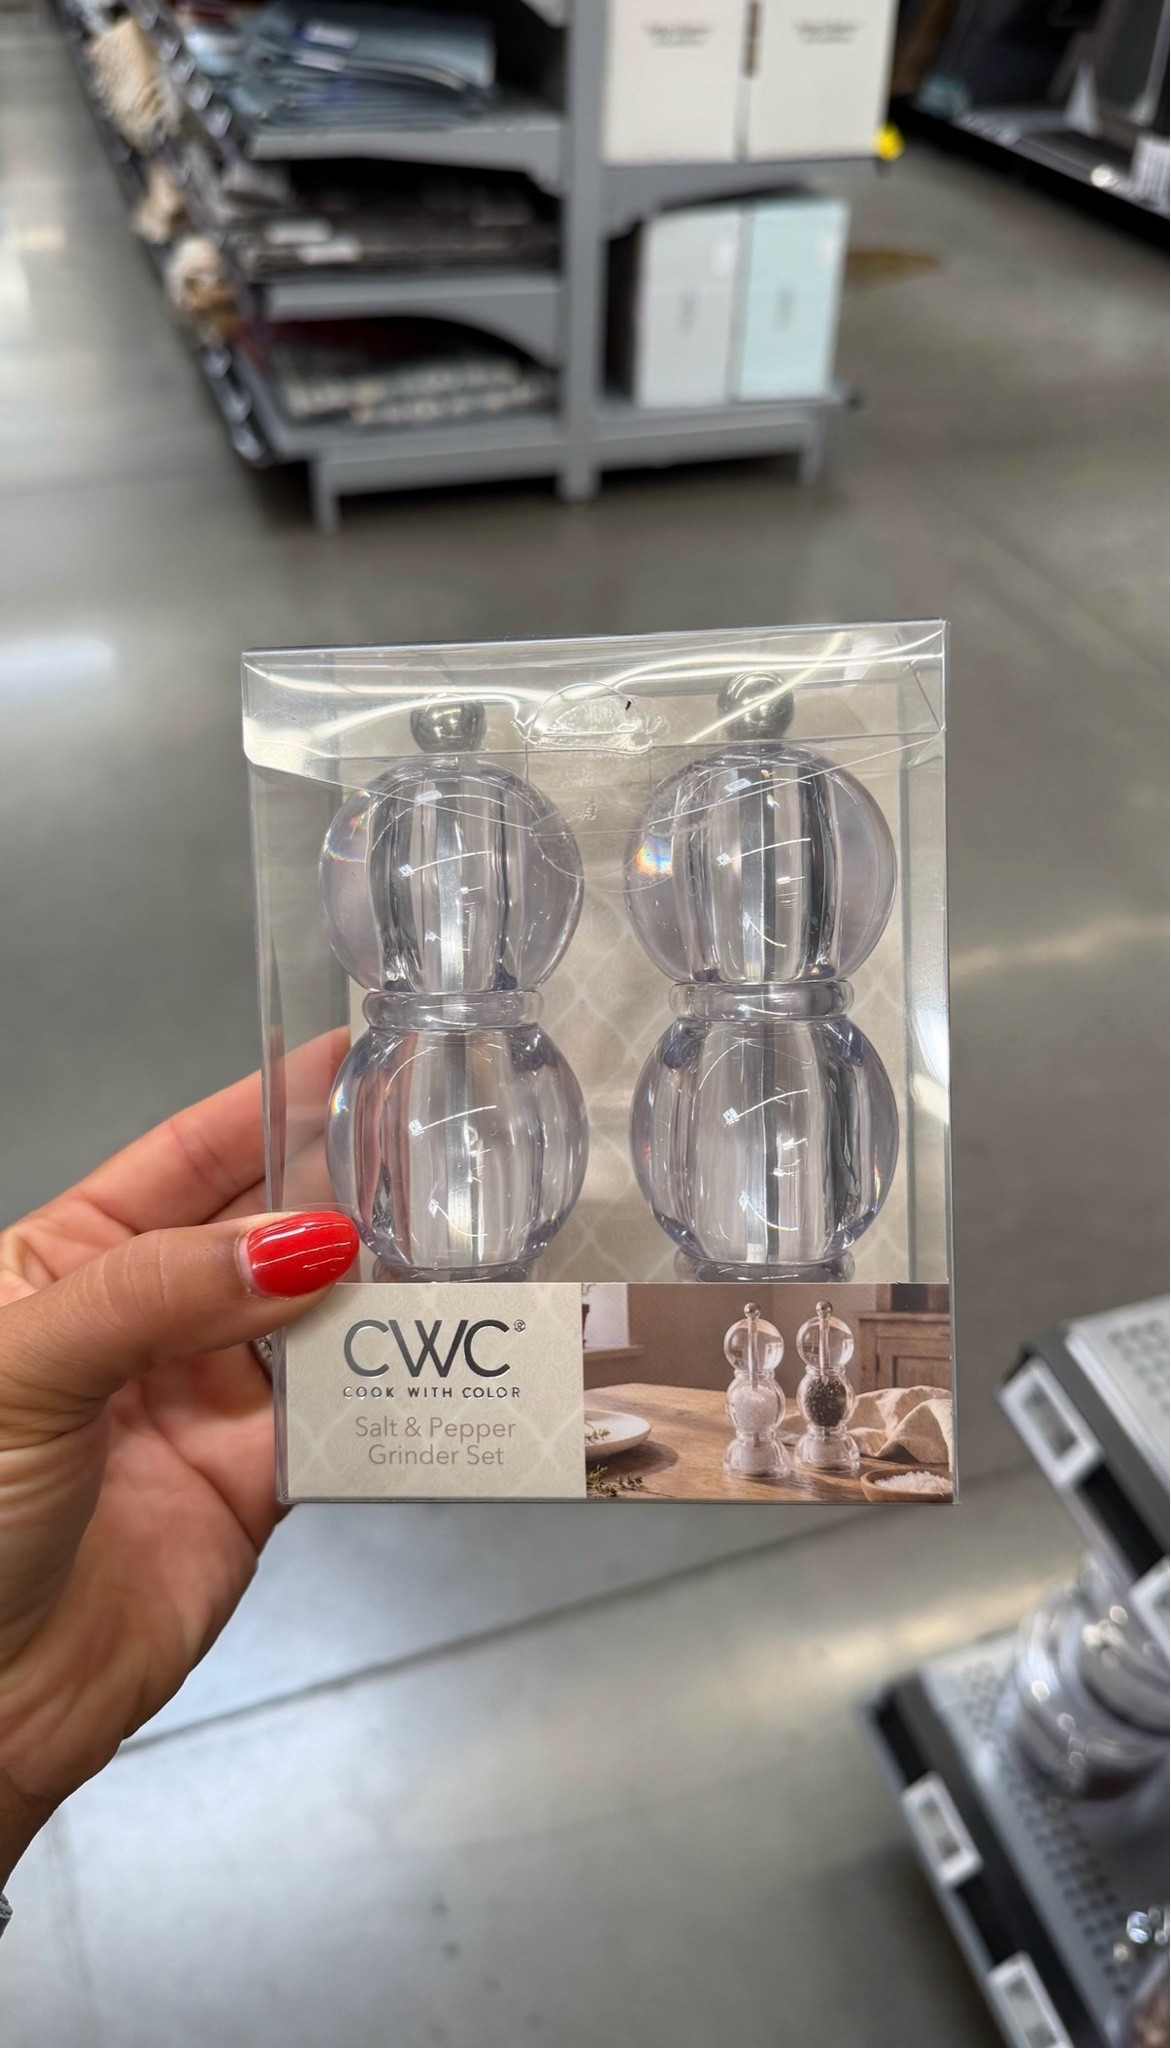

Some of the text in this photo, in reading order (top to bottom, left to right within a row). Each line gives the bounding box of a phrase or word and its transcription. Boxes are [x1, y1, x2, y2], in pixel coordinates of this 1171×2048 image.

[343, 1386, 521, 1399] COOK WITH COLOR
[355, 1416, 516, 1442] Salt & Pepper
[368, 1444, 504, 1465] Grinder Set
